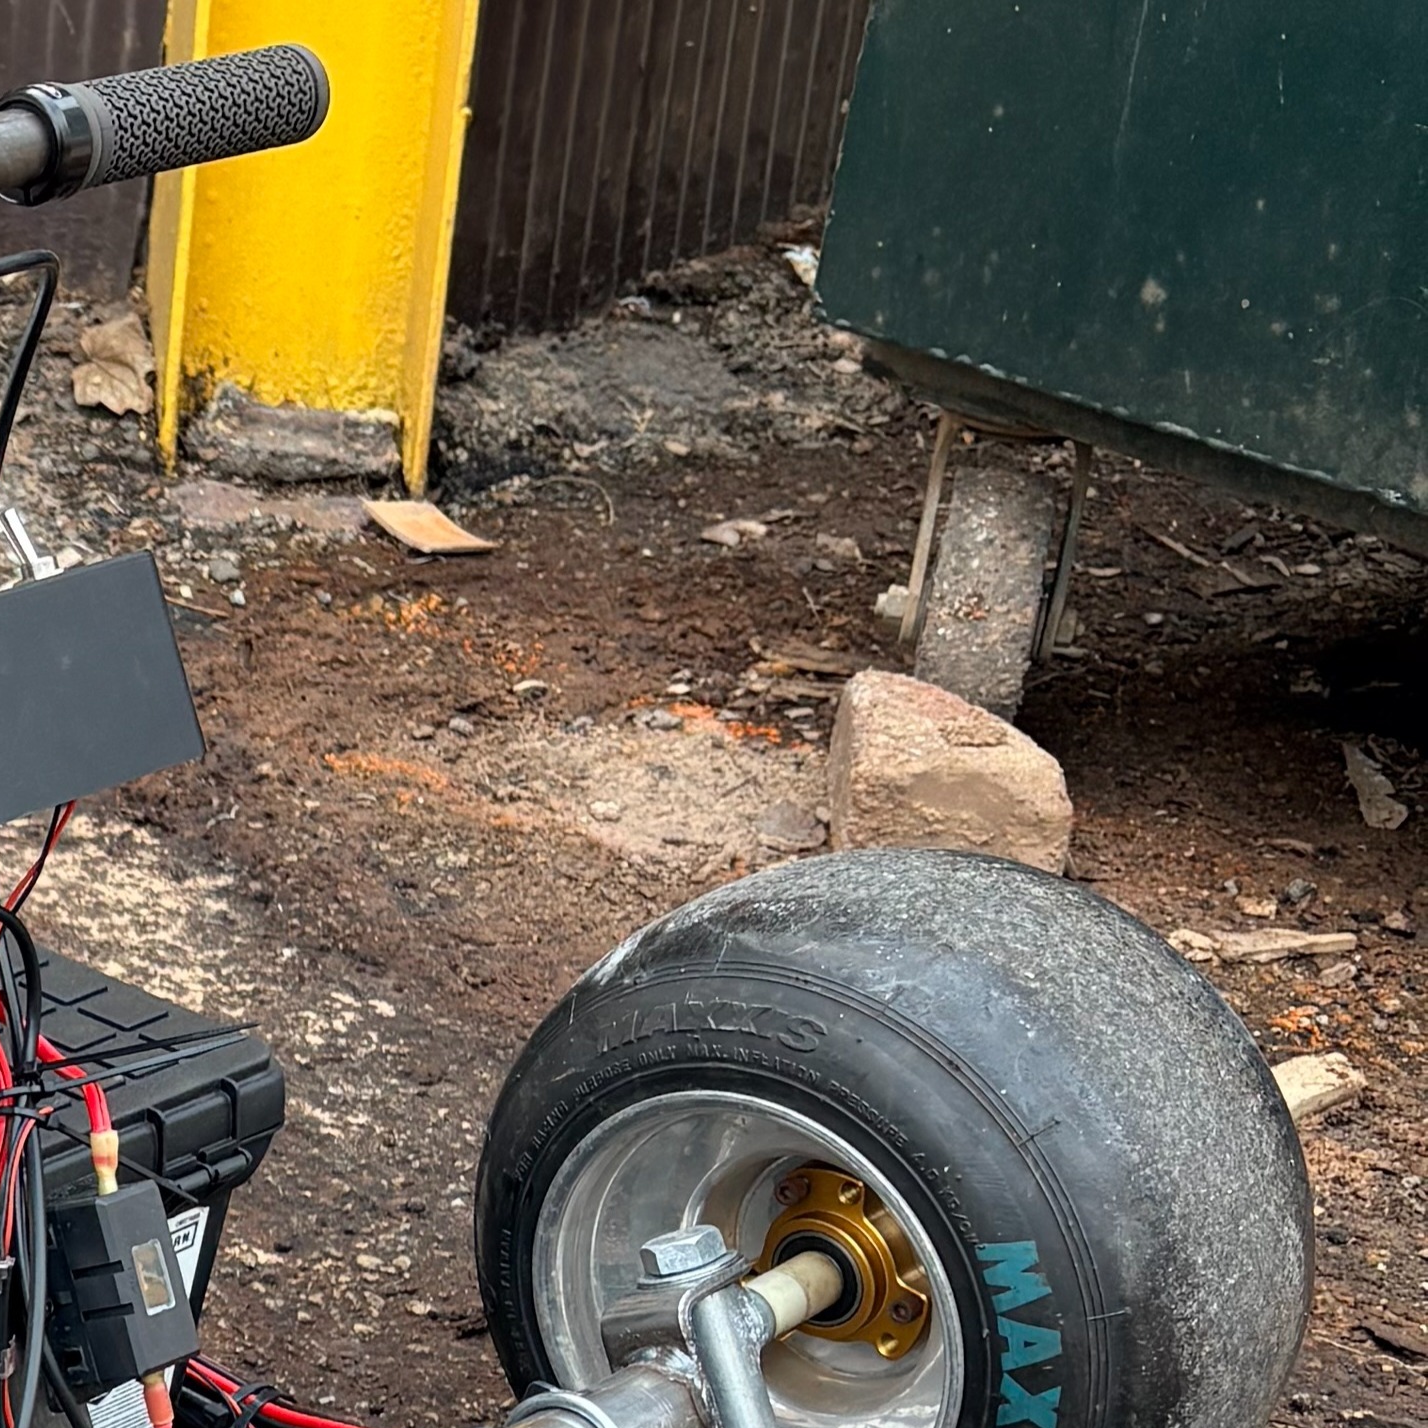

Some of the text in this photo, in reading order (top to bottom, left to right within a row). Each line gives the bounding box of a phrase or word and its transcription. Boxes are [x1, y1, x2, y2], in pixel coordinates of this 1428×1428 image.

[572, 1059, 633, 1100] PURPOSE
[639, 1045, 677, 1066] ONLY
[687, 1043, 730, 1059] MAX.
[733, 1047, 822, 1083] INFLATION
[829, 1079, 910, 1149] PRESSURE
